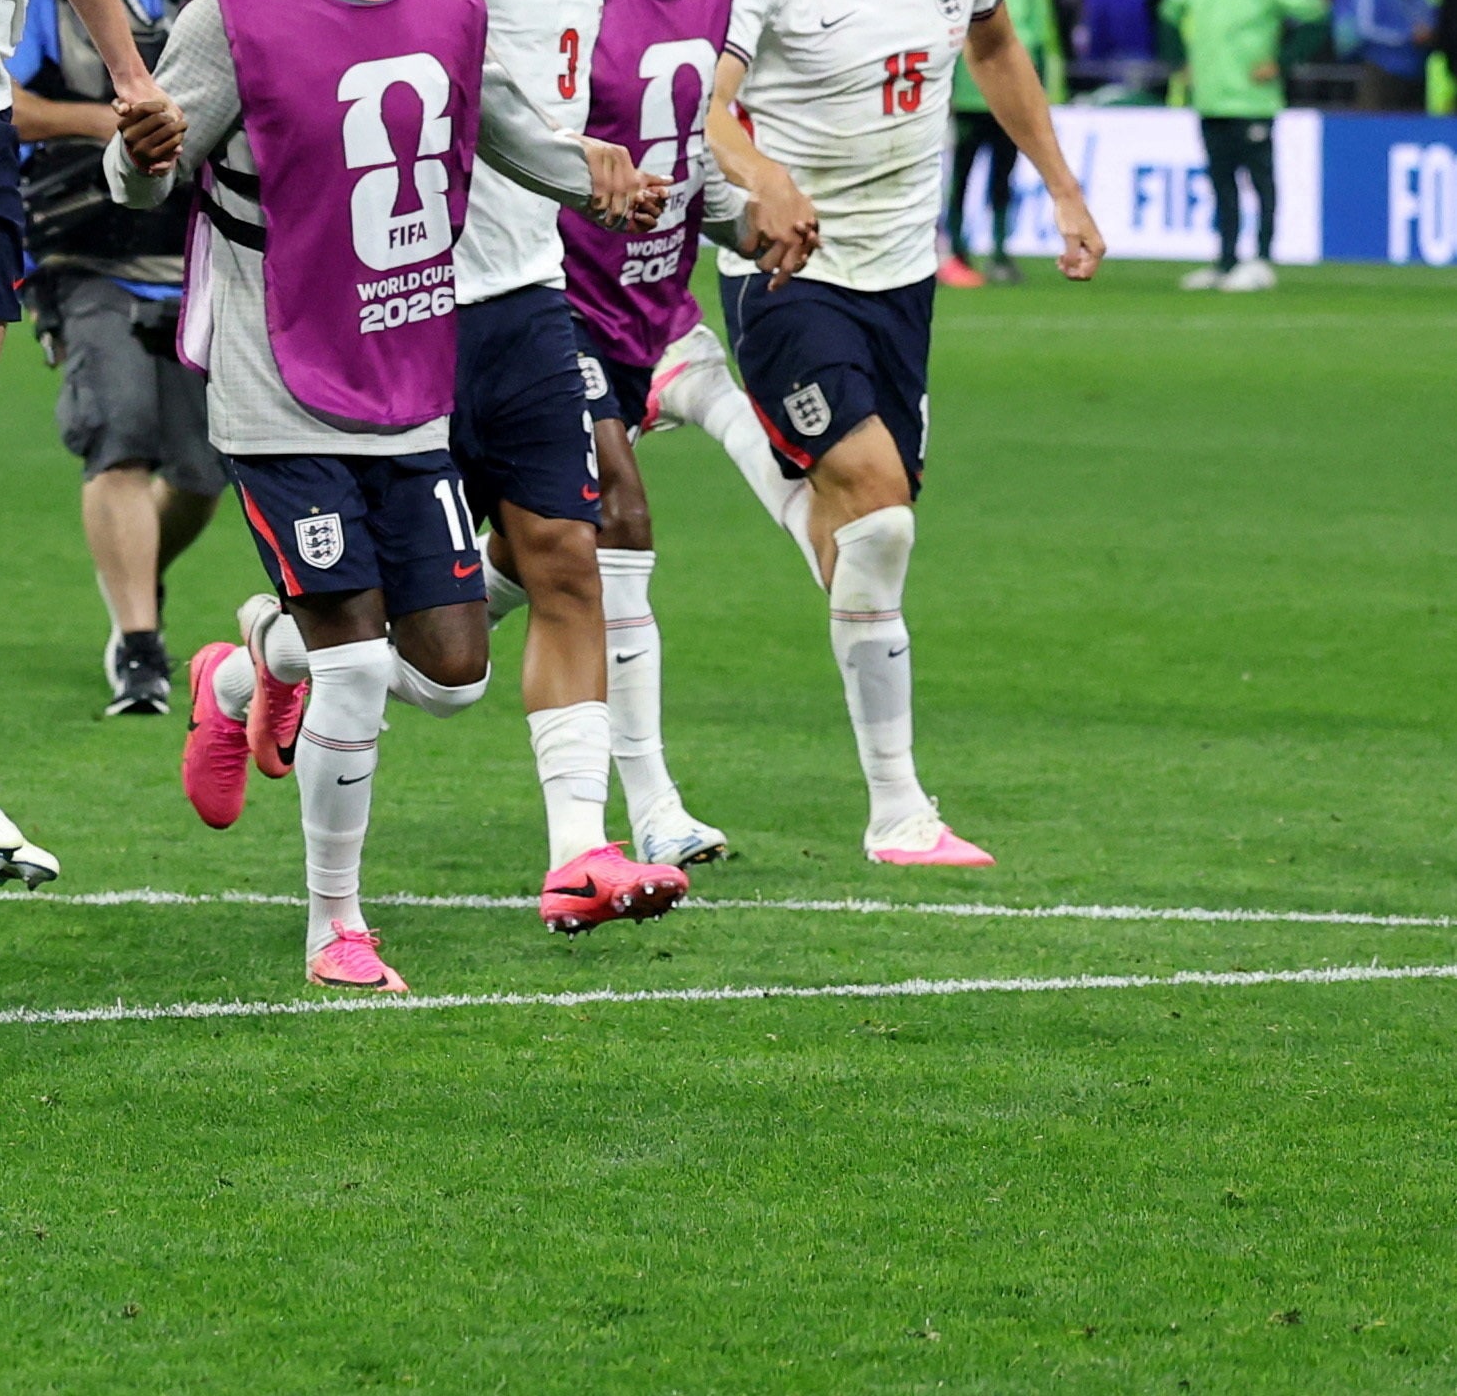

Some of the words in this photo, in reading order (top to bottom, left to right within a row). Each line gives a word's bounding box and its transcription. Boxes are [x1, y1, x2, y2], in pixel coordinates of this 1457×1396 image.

[558, 28, 579, 99] 3
[883, 51, 930, 116] 15
[1132, 164, 1221, 232] FIF
[1388, 142, 1457, 266] FO
[388, 221, 428, 250] FIFA
[357, 270, 419, 302] WORLD
[417, 264, 456, 285] CUP
[619, 248, 682, 287] 202
[359, 287, 456, 334] 2026
